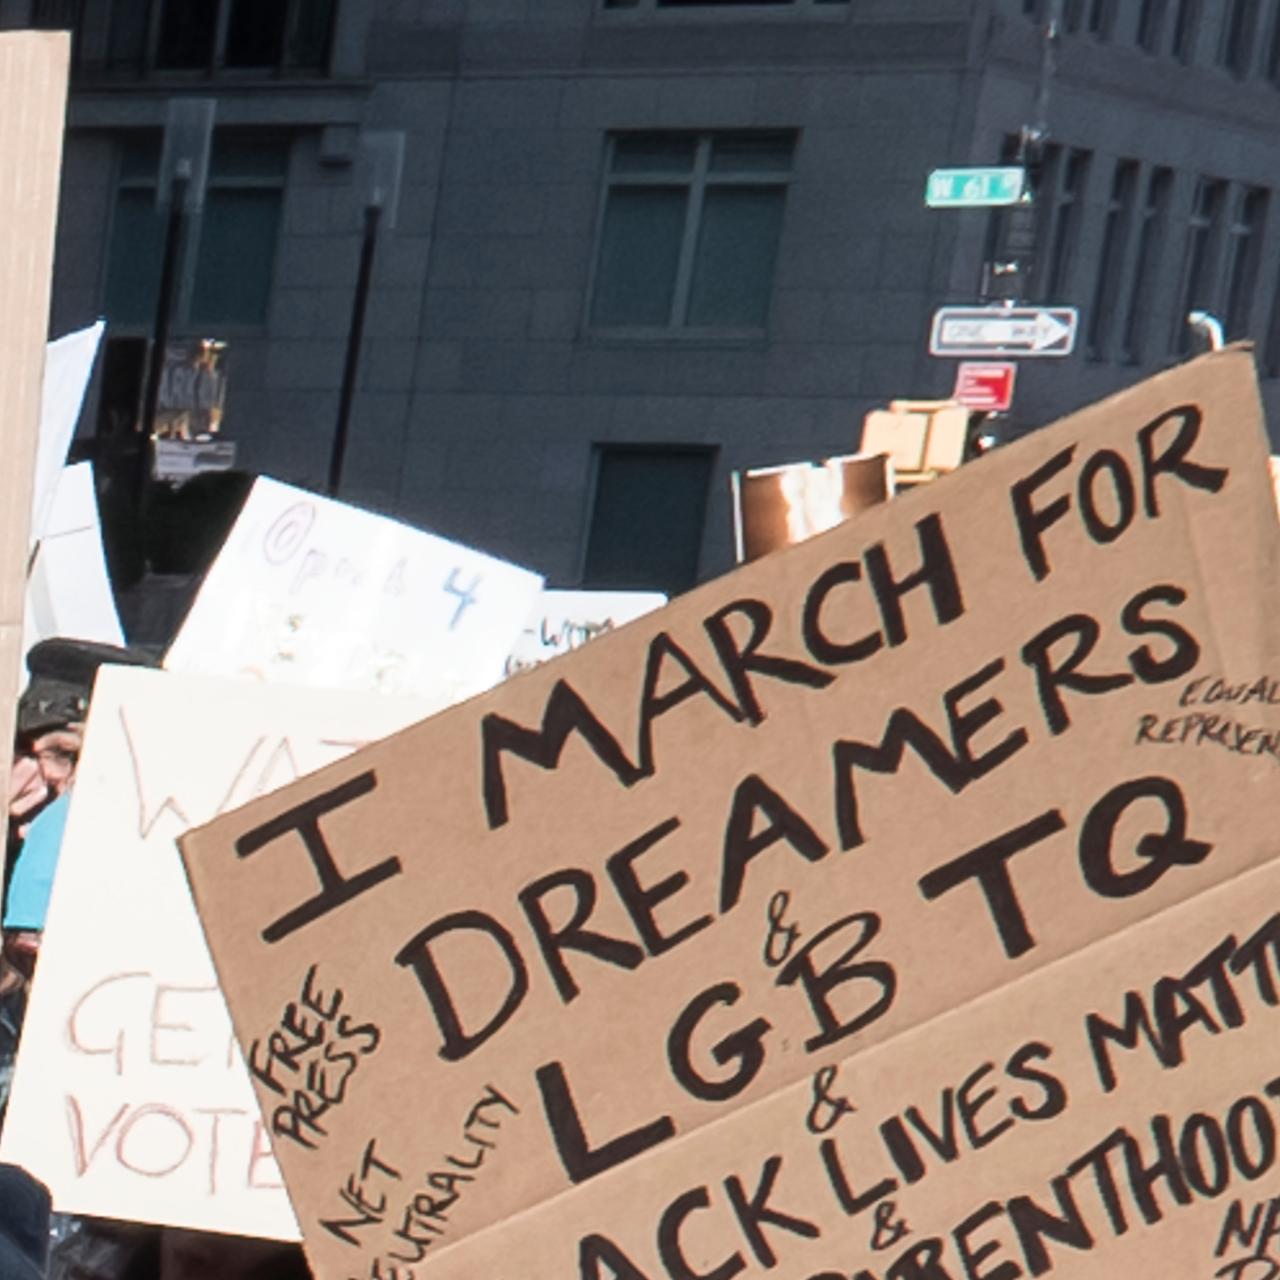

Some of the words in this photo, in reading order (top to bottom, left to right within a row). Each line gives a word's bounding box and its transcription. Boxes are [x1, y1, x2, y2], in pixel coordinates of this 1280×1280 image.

[233, 769, 403, 945] I
[479, 511, 968, 833] MARCH
[1009, 403, 1231, 583] FOR
[393, 583, 1202, 1063] DREAMERS
[763, 889, 803, 970] &
[249, 963, 343, 1097] FREE
[272, 1014, 381, 1151] PRESS
[820, 1039, 1069, 1217] LIVES
[1085, 910, 1280, 1094] MATT
[806, 1063, 858, 1136] &
[317, 1137, 402, 1248] NET
[871, 1200, 914, 1252] &
